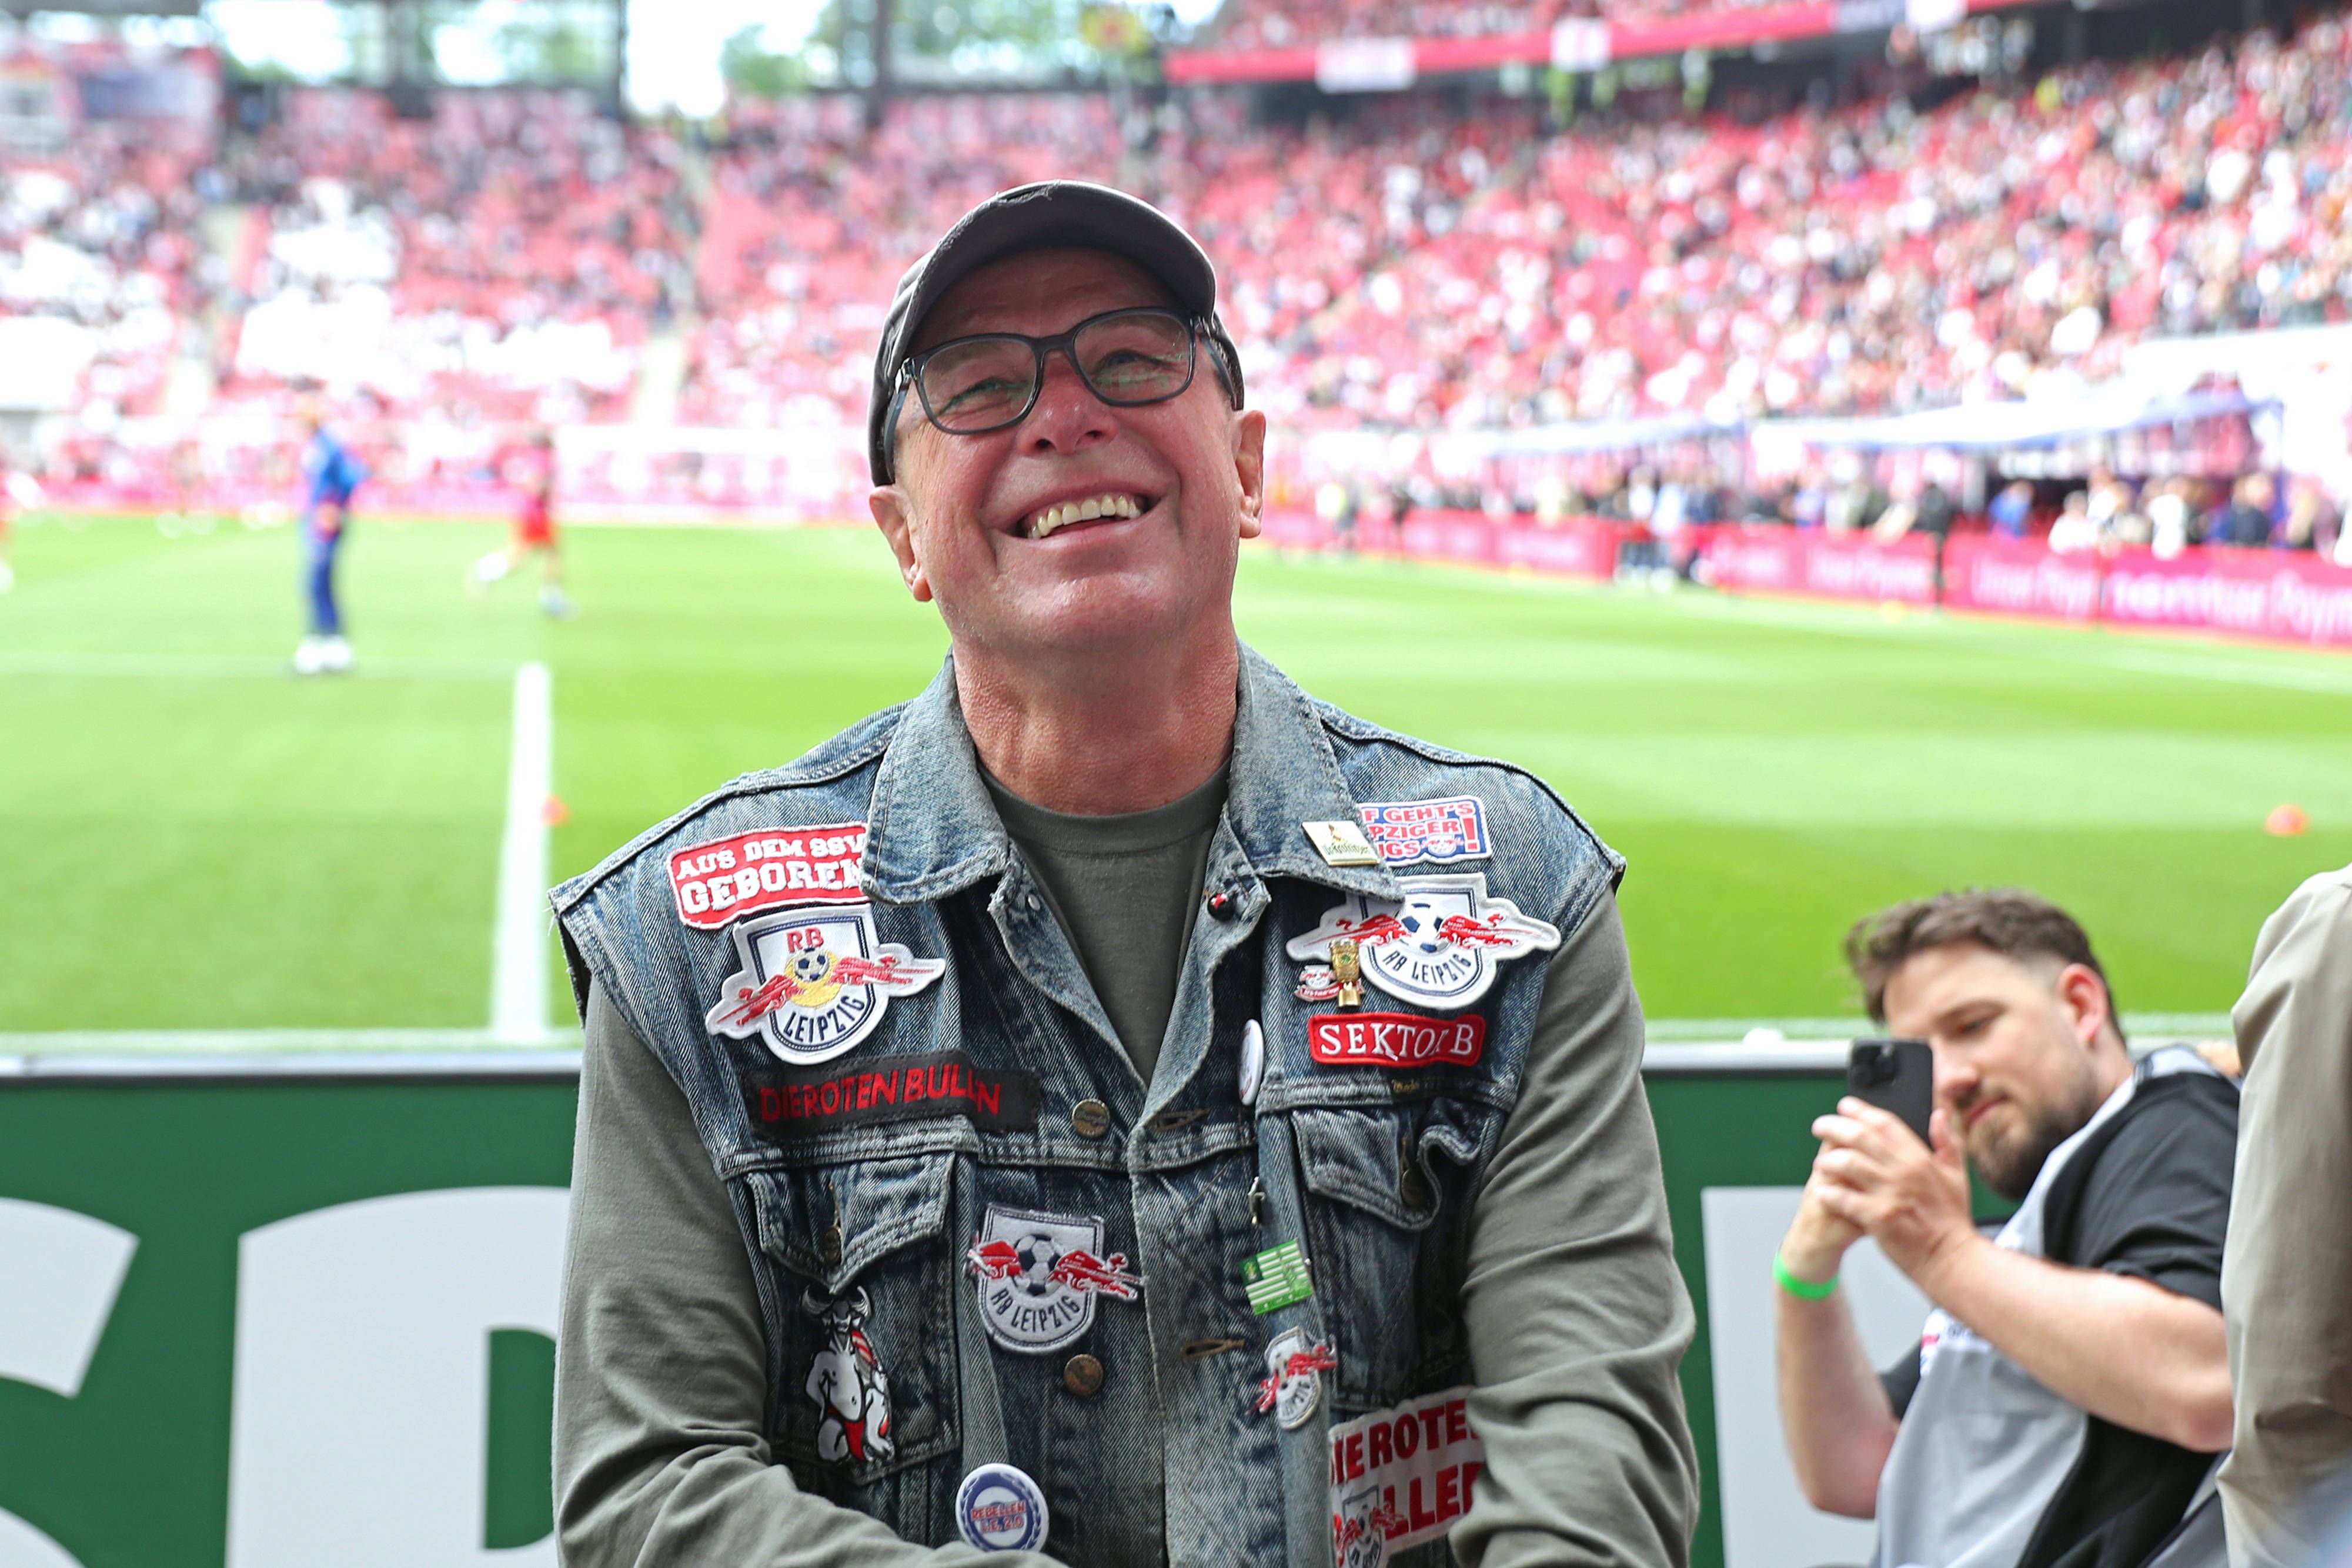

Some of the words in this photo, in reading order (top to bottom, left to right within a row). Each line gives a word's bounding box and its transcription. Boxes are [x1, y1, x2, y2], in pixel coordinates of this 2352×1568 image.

[1362, 809, 1377, 822] F
[1385, 803, 1474, 823] GEHT'S
[1367, 820, 1459, 839] PZIGER
[676, 848, 736, 880] AUS
[743, 838, 806, 862] DEM
[809, 833, 866, 858] SSV
[786, 927, 824, 954] RB
[1382, 950, 1408, 971] RB
[1411, 953, 1472, 985] LEIPZIG
[783, 995, 865, 1043] LEIPZIG
[1449, 1023, 1474, 1056] B
[903, 1064, 1000, 1115] BULLN
[991, 1288, 1014, 1315] RB
[1011, 1295, 1080, 1332] LEIPZIG
[1331, 1431, 1365, 1487] IE
[1368, 1398, 1481, 1470] ROTE
[971, 1500, 1027, 1521] REBELLEN
